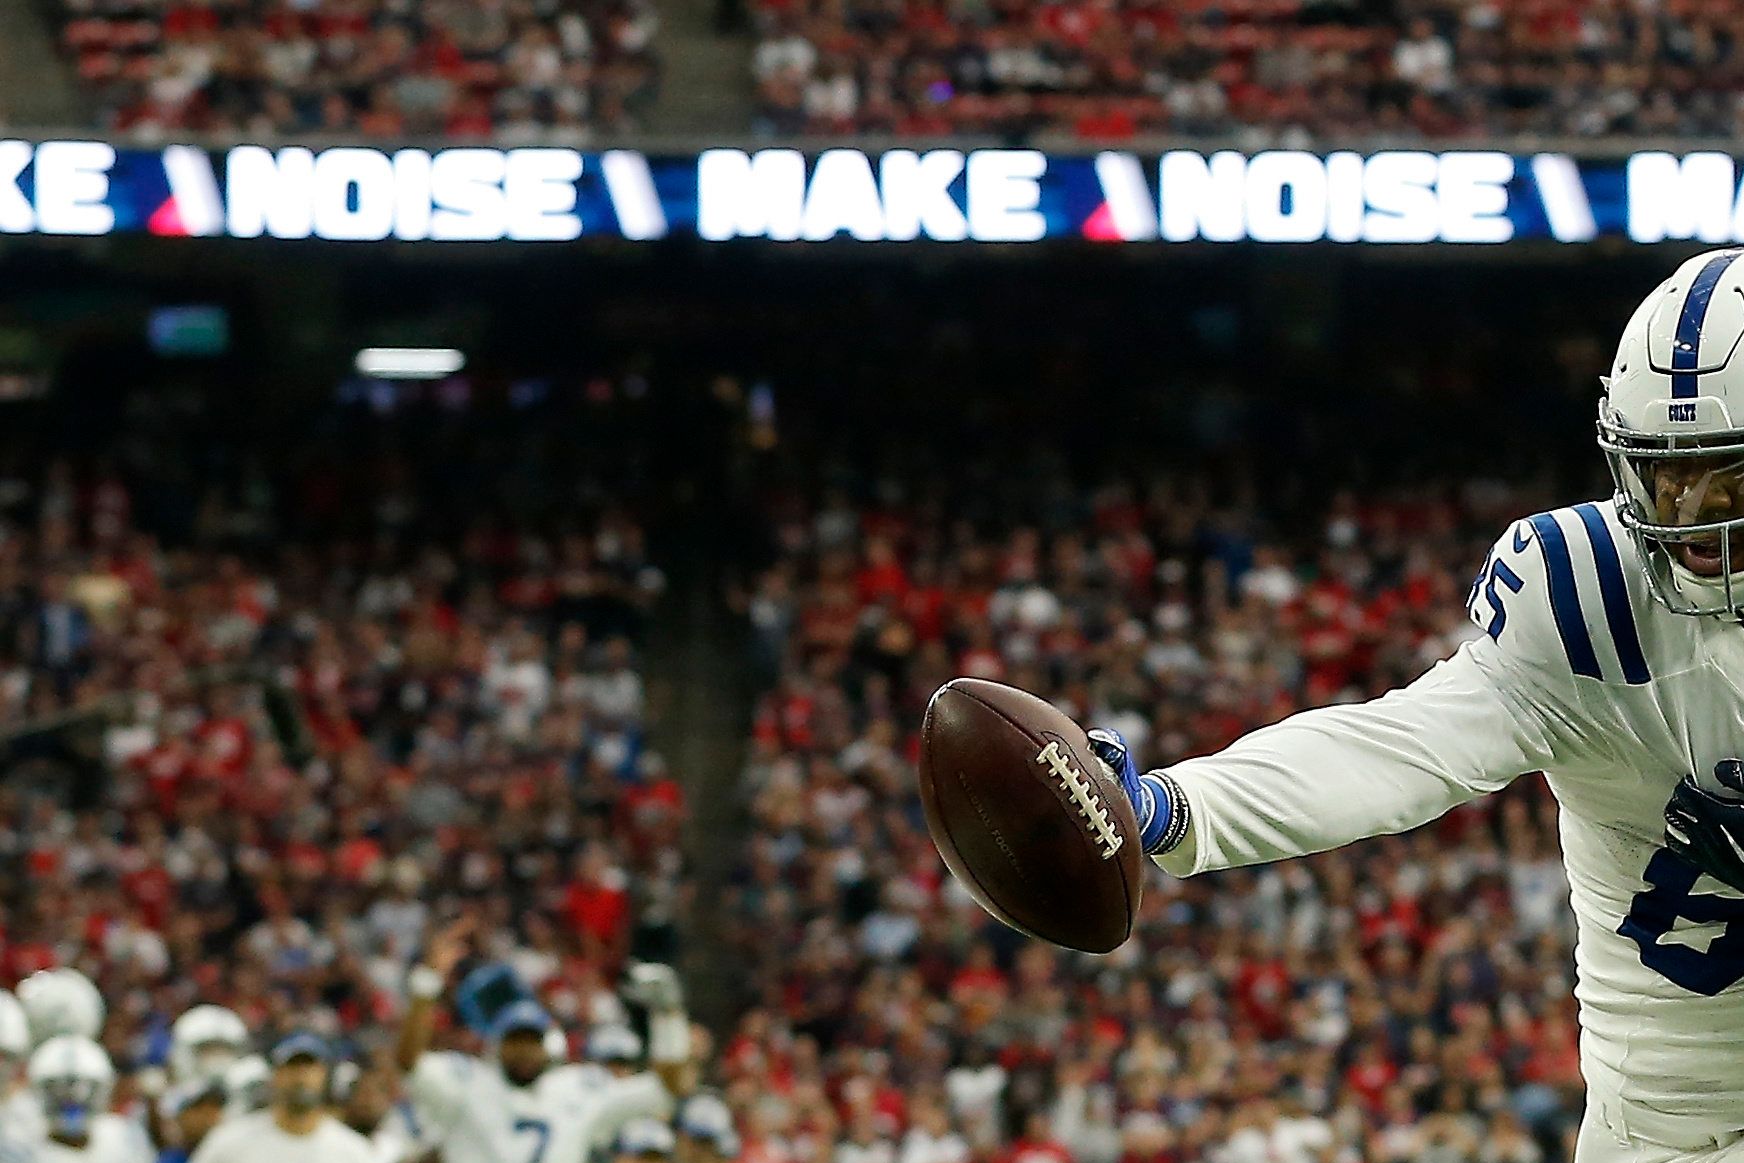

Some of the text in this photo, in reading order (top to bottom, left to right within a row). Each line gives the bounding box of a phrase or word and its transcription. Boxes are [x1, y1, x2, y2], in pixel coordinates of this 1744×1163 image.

[226, 145, 584, 241] NOISE
[697, 148, 1047, 242] MAKE
[1159, 150, 1515, 243] NOISE
